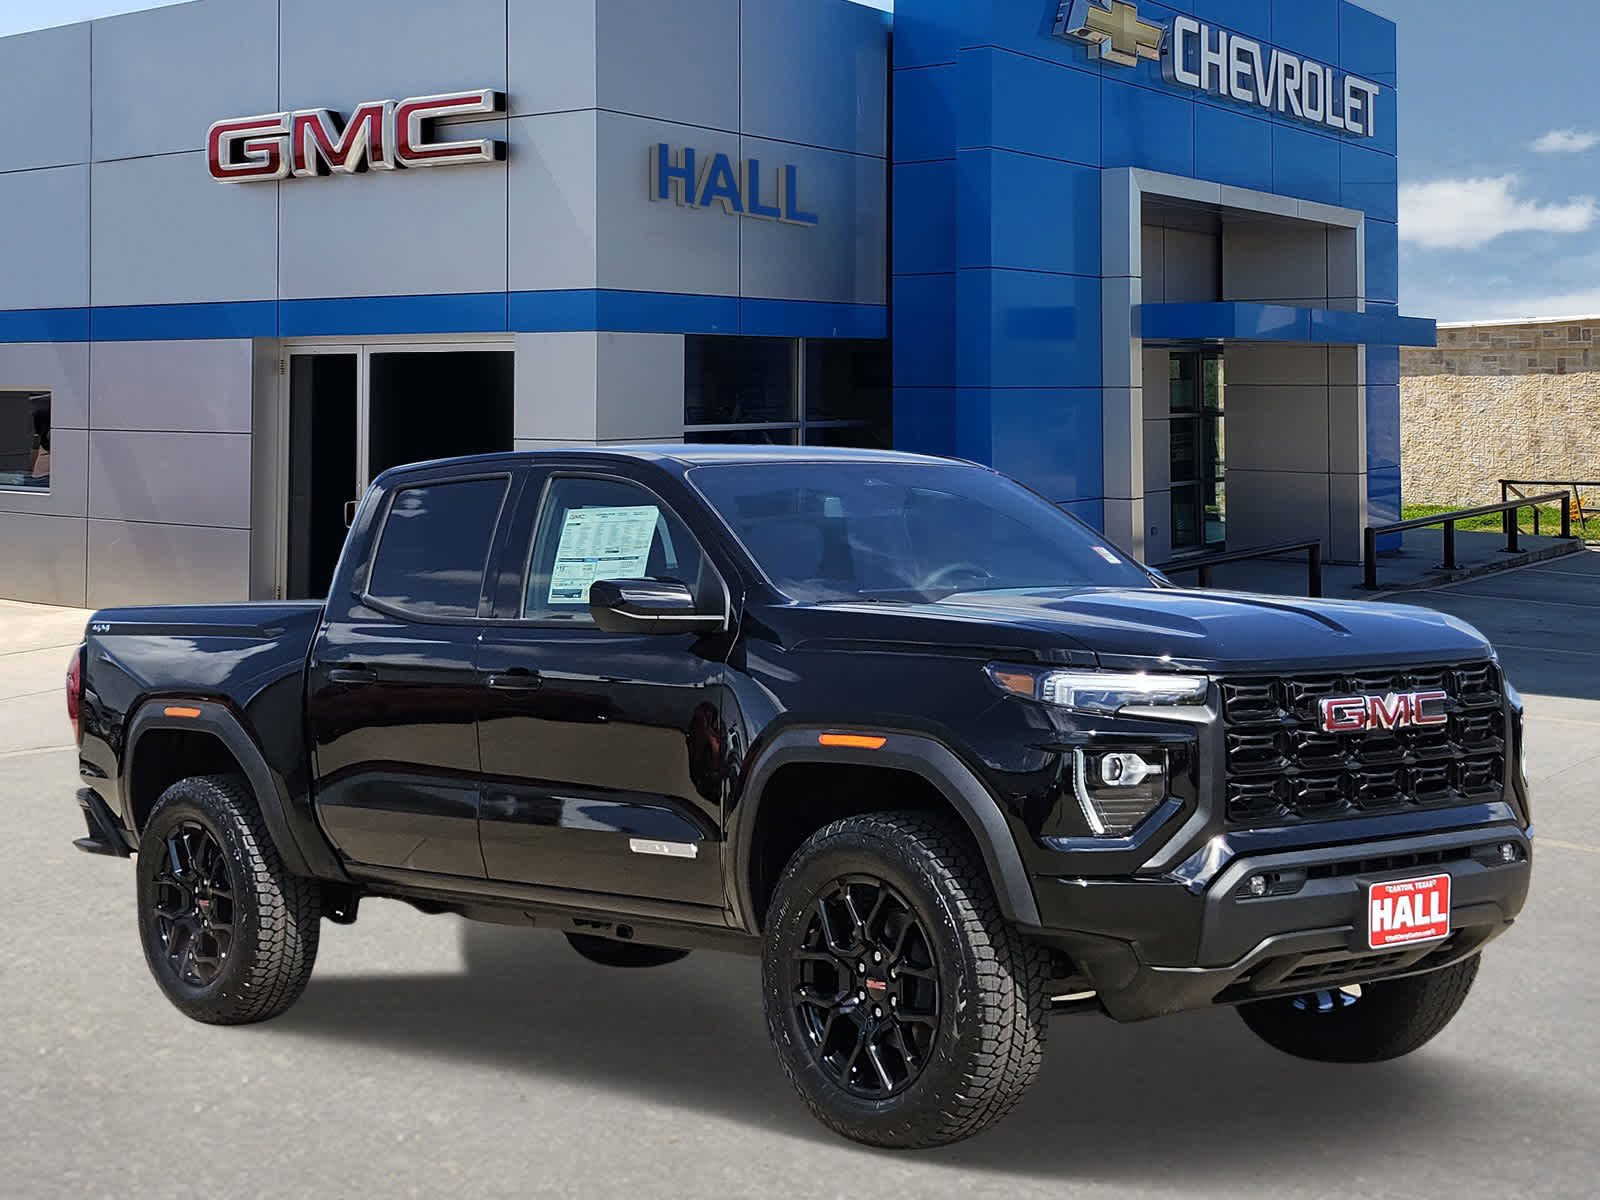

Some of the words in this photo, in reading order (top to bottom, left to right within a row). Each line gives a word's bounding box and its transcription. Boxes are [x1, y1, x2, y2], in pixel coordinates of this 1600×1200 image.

[1174, 16, 1379, 137] CHEVROLET
[208, 89, 503, 184] GMC
[652, 143, 818, 225] HALL
[1320, 690, 1447, 731] GMC
[1372, 891, 1447, 932] HALL
